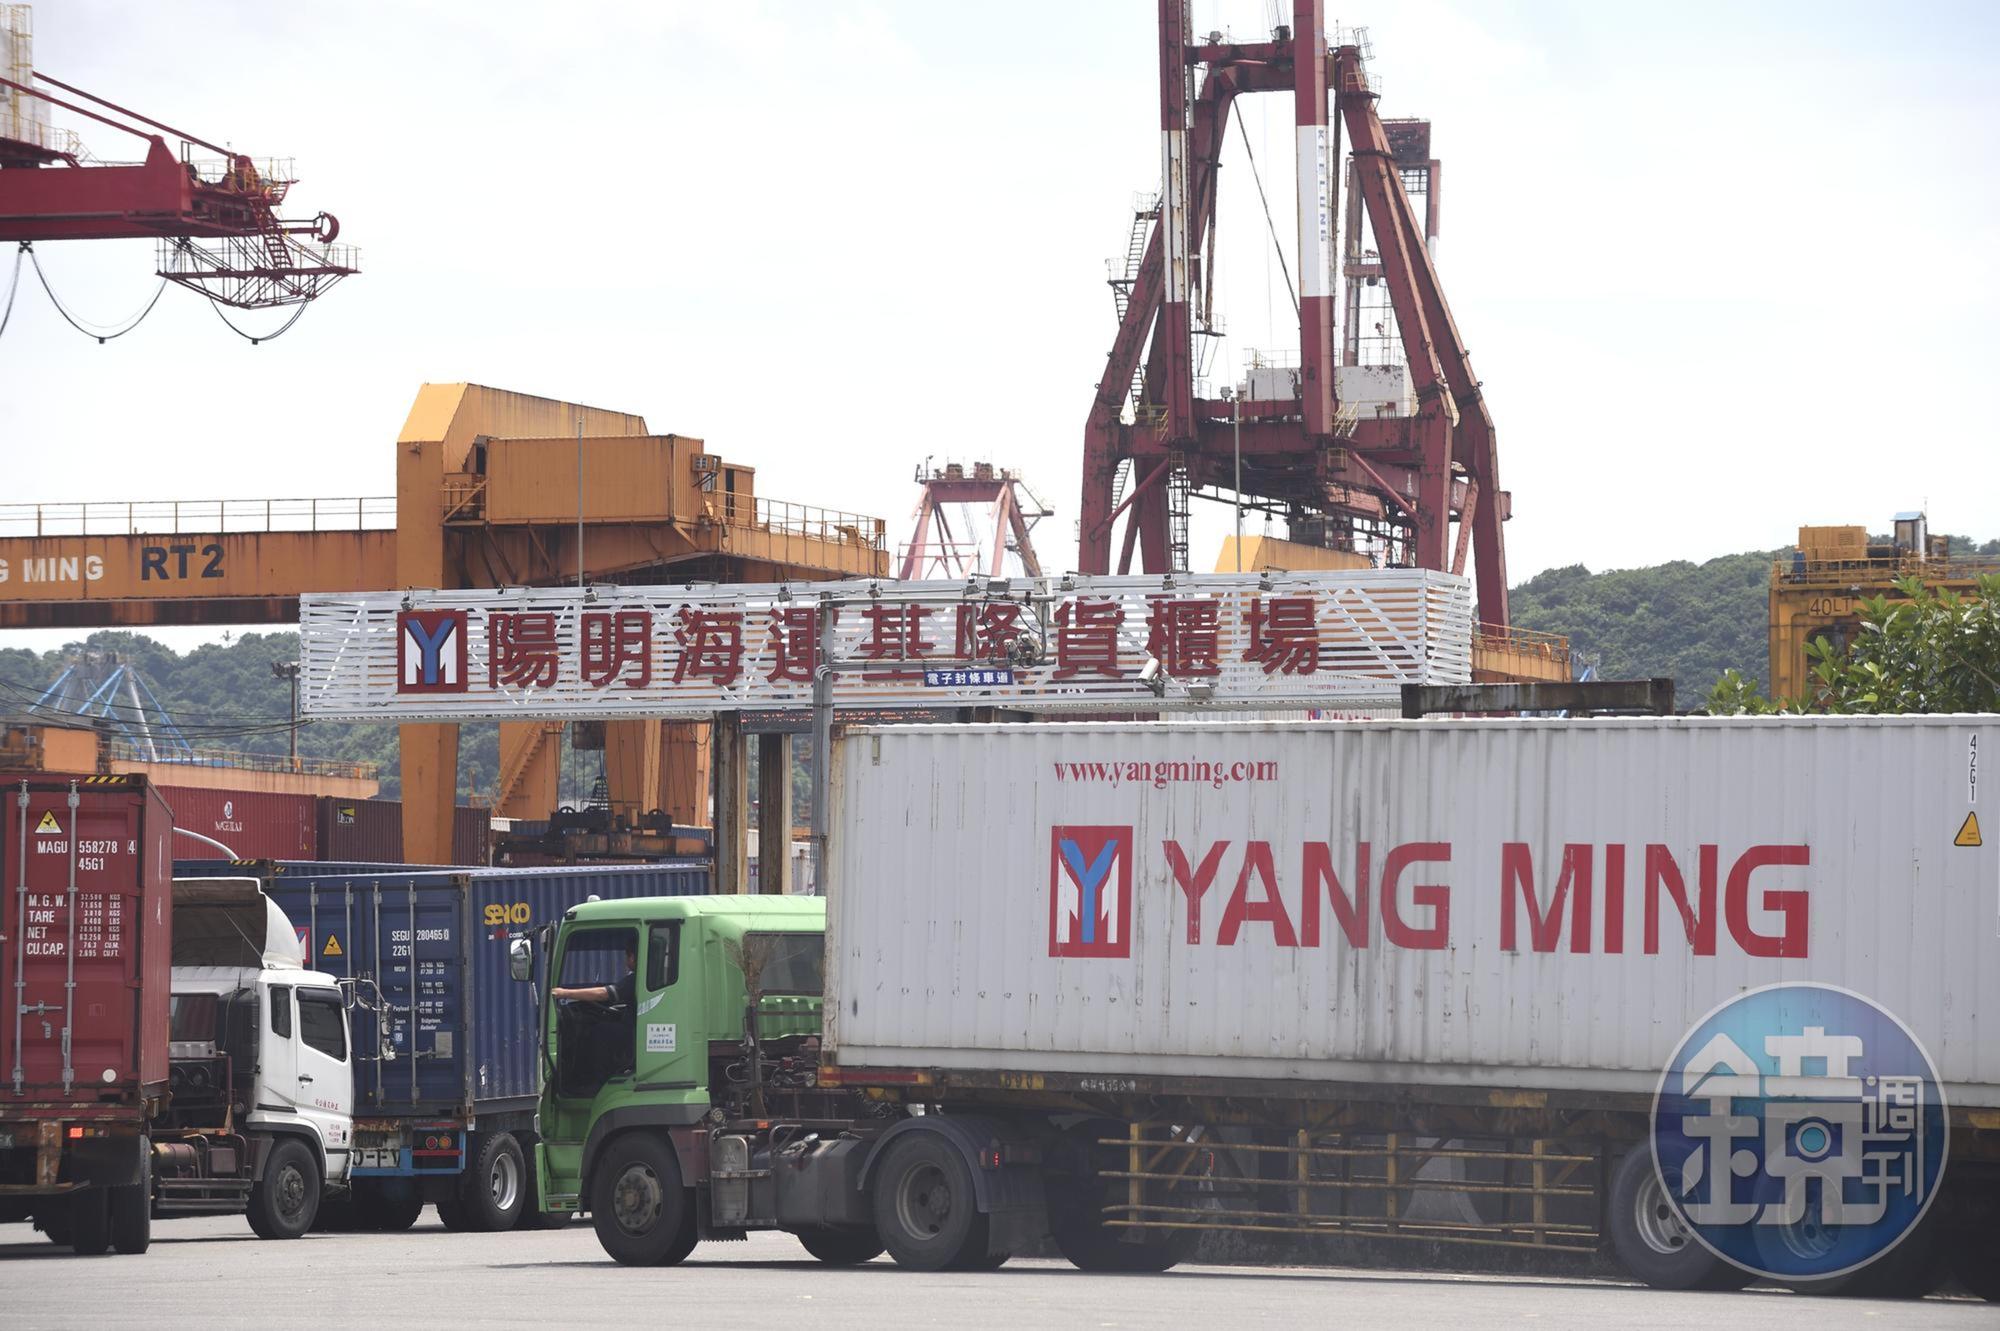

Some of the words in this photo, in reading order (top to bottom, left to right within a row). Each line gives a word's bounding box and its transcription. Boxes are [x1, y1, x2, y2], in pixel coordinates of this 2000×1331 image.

[23, 555, 104, 583] MING
[141, 543, 225, 581] RT2
[927, 671, 1009, 685] 電子封條車道
[1054, 755, 1279, 790] www.yangming.com
[37, 841, 68, 854] MAGU
[79, 841, 118, 854] 558278
[128, 840, 136, 854] 4
[78, 857, 104, 870] 45G1
[1161, 840, 1452, 950] YANG
[1499, 842, 1810, 959] MING
[28, 910, 55, 923] TARE
[27, 926, 47, 939] NET
[391, 929, 411, 942] SEGU
[416, 929, 443, 941] 280465
[392, 945, 411, 957] 22G1
